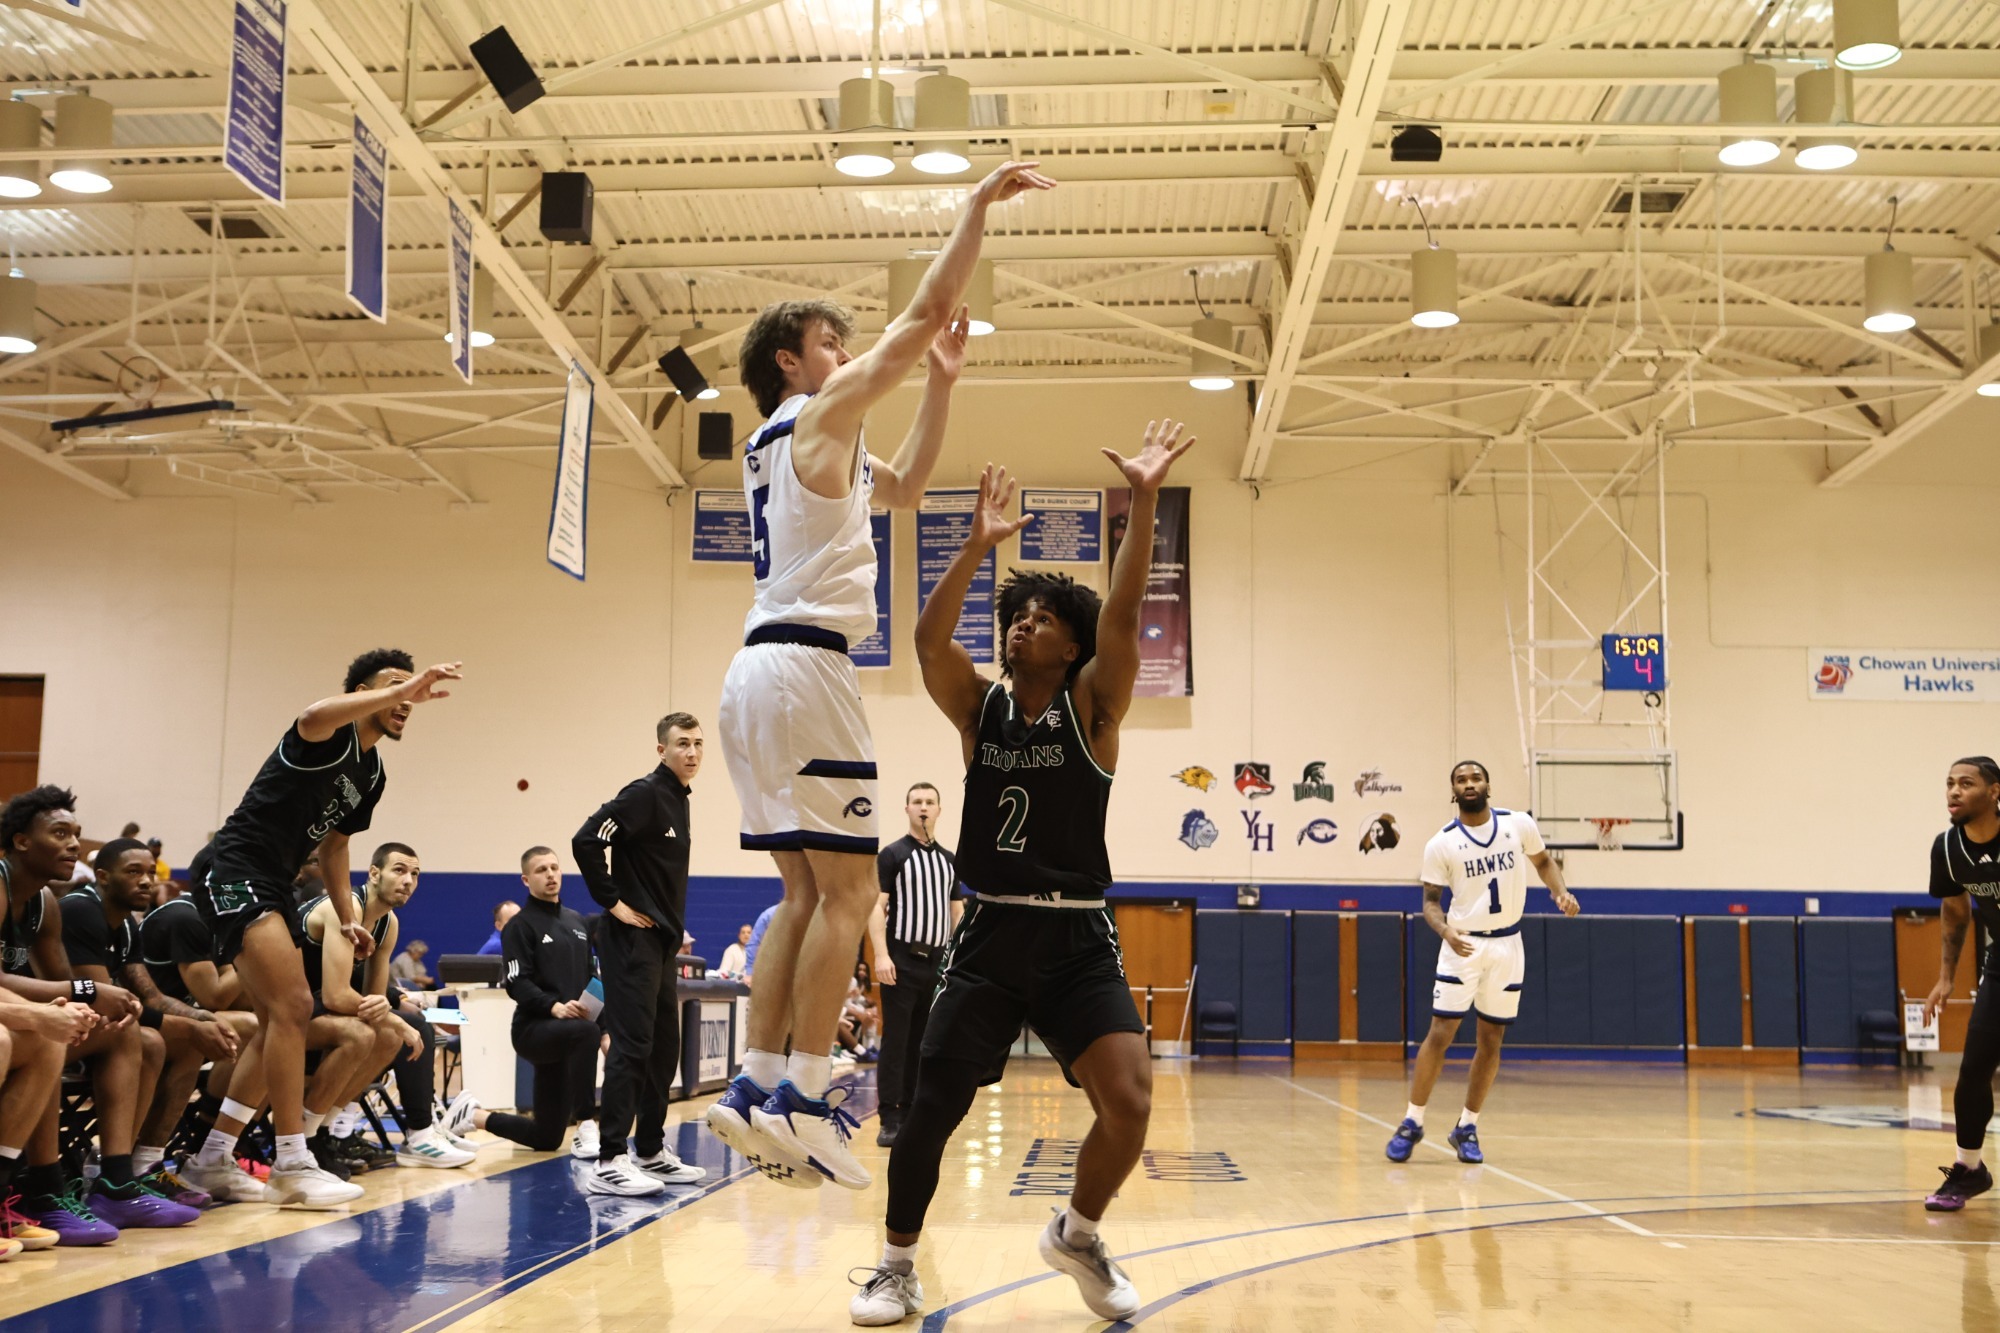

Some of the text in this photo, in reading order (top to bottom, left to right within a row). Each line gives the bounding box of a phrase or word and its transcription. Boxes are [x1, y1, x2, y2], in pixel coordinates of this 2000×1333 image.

[1147, 593, 1180, 602] University
[1615, 638, 1659, 656] 15:09
[1634, 658, 1652, 684] 4
[1859, 656, 2000, 671] Chowan Universi
[1904, 675, 1974, 692] Hawks
[997, 786, 1029, 853] 2
[1464, 851, 1515, 878] HAWKS
[1488, 877, 1502, 914] 1
